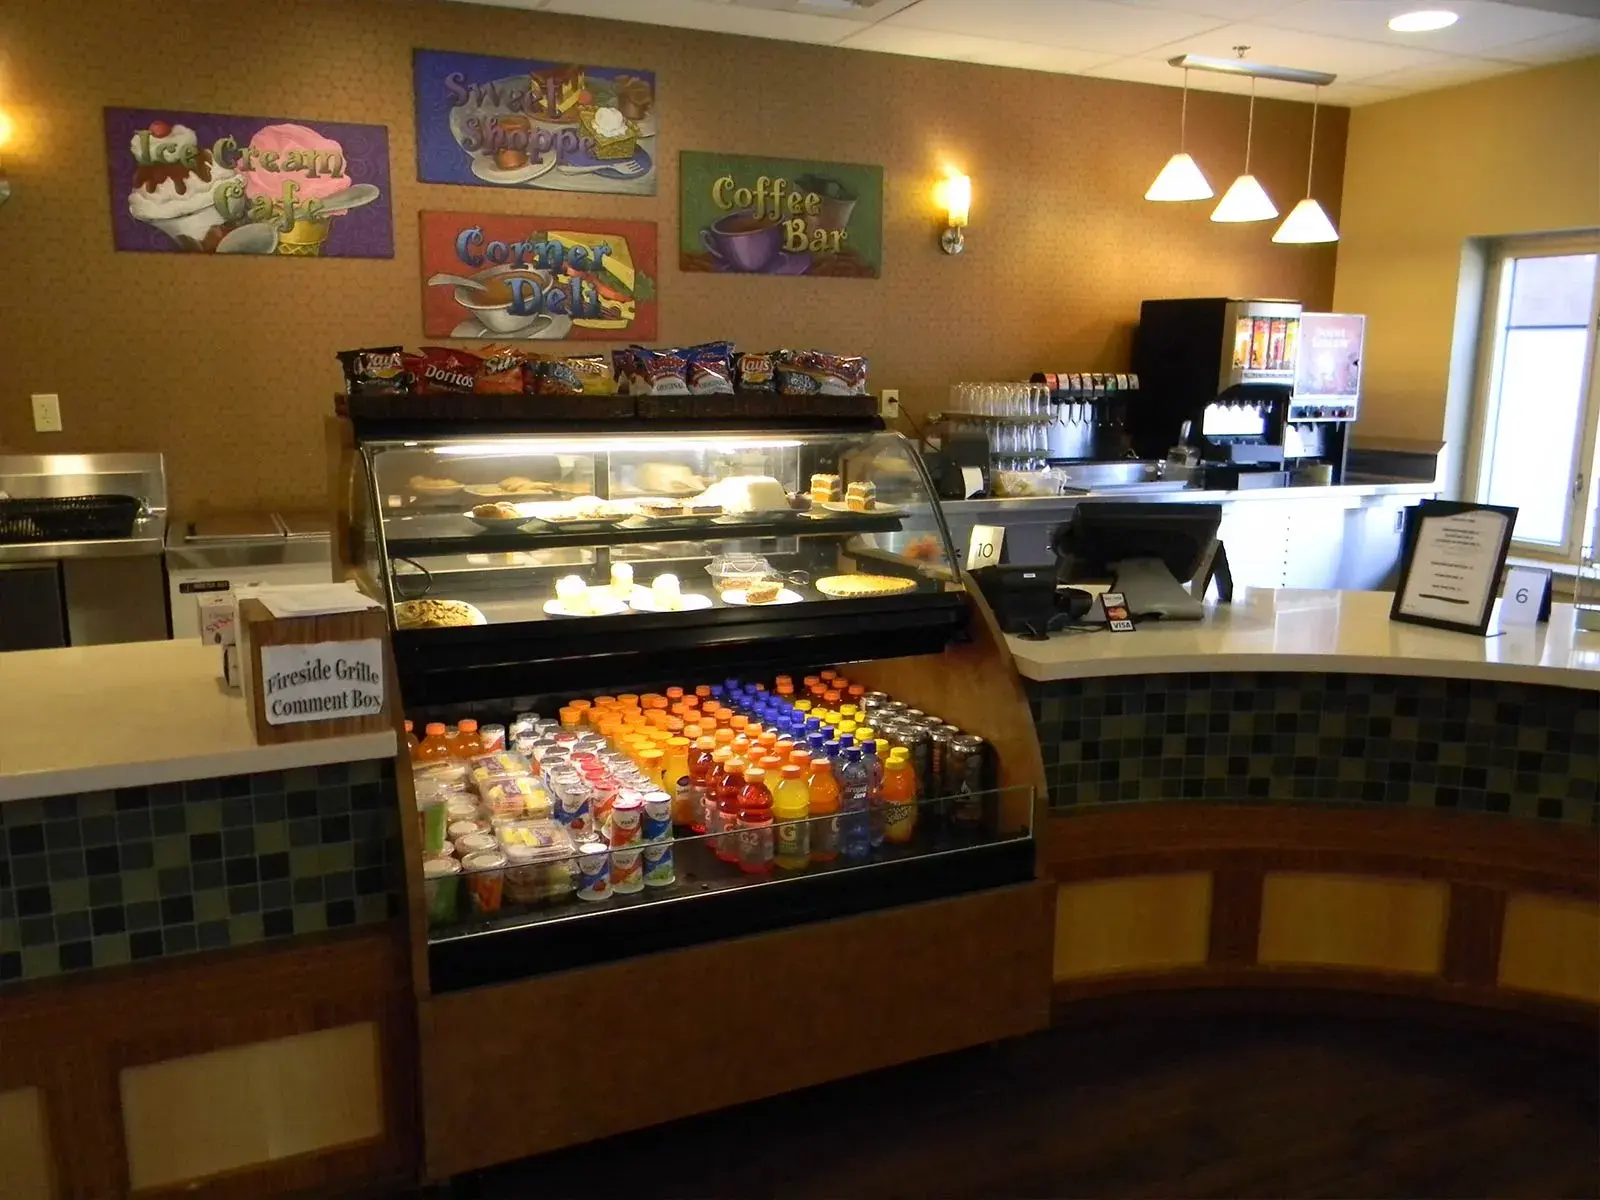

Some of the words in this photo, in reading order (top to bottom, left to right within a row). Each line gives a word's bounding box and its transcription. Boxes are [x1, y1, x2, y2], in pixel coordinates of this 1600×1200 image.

[445, 72, 562, 118] Sweet
[132, 129, 198, 167] Ice
[213, 135, 343, 178] Cream
[463, 117, 597, 165] Shoppe
[213, 180, 325, 233] Cafe
[712, 174, 822, 220] Coffee
[456, 226, 612, 271] Corner
[782, 218, 848, 254] Bar
[504, 277, 599, 318] Deli
[425, 364, 473, 387] Doritos
[977, 542, 994, 558] 10
[1515, 588, 1529, 604] 6
[1112, 621, 1131, 629] VISA
[266, 658, 331, 695] Fireside
[335, 658, 379, 684] Grille
[271, 692, 348, 718] Comment
[351, 690, 381, 709] Box
